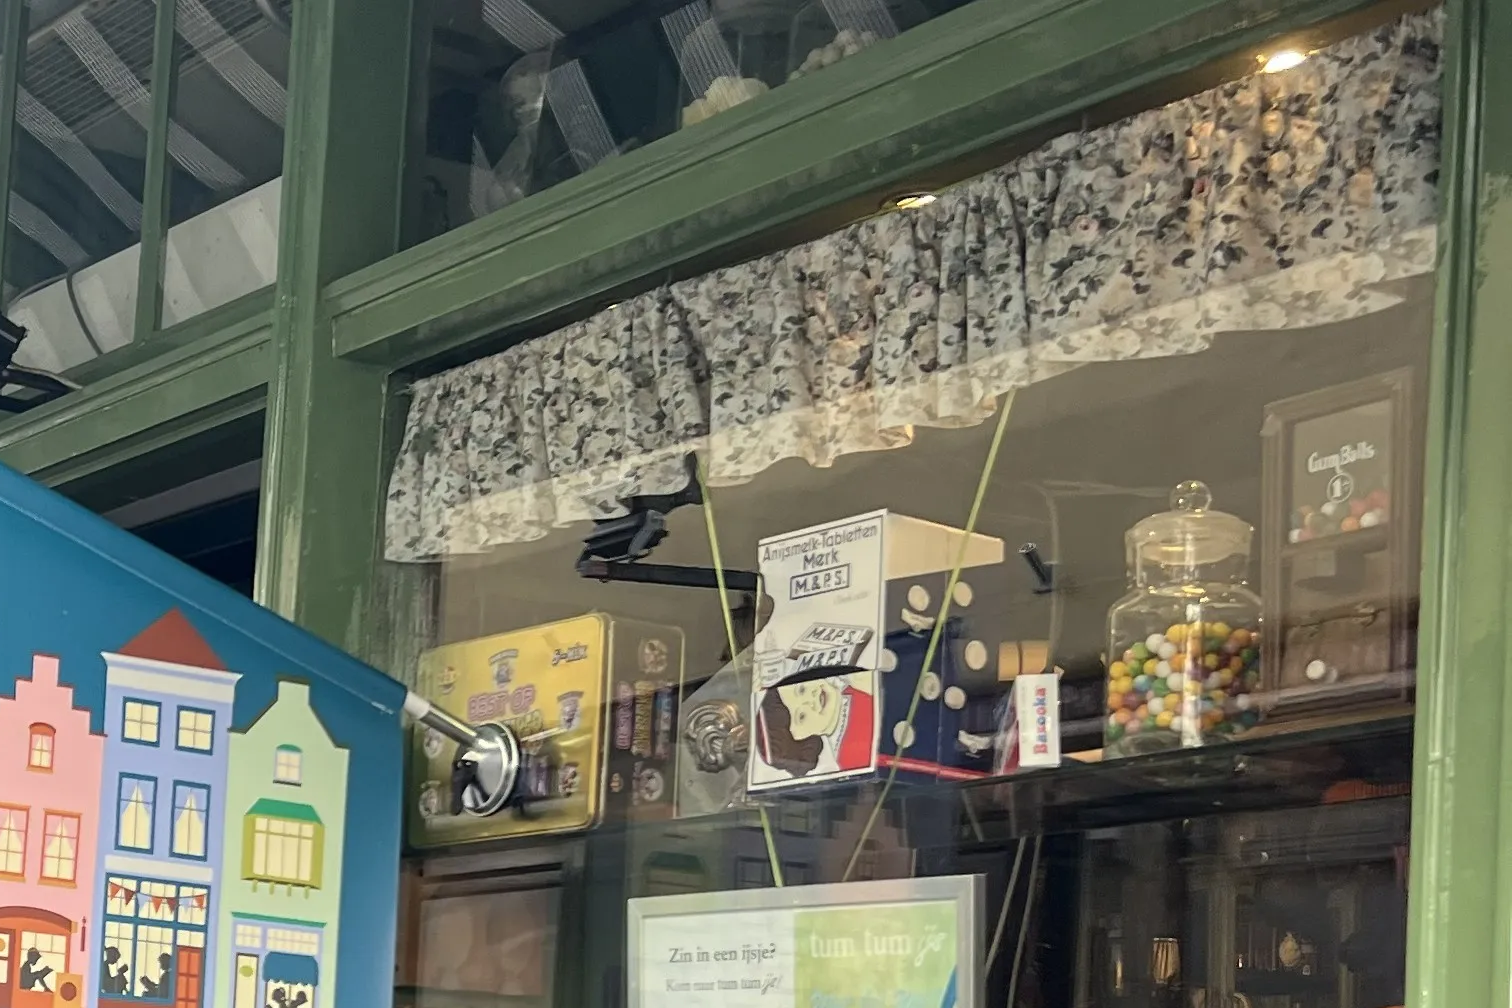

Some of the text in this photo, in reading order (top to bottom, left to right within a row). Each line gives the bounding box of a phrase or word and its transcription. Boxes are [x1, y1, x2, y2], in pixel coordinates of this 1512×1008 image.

[803, 549, 839, 571] Merk
[668, 947, 693, 964] Zin
[696, 945, 710, 962] in
[713, 949, 738, 962] een
